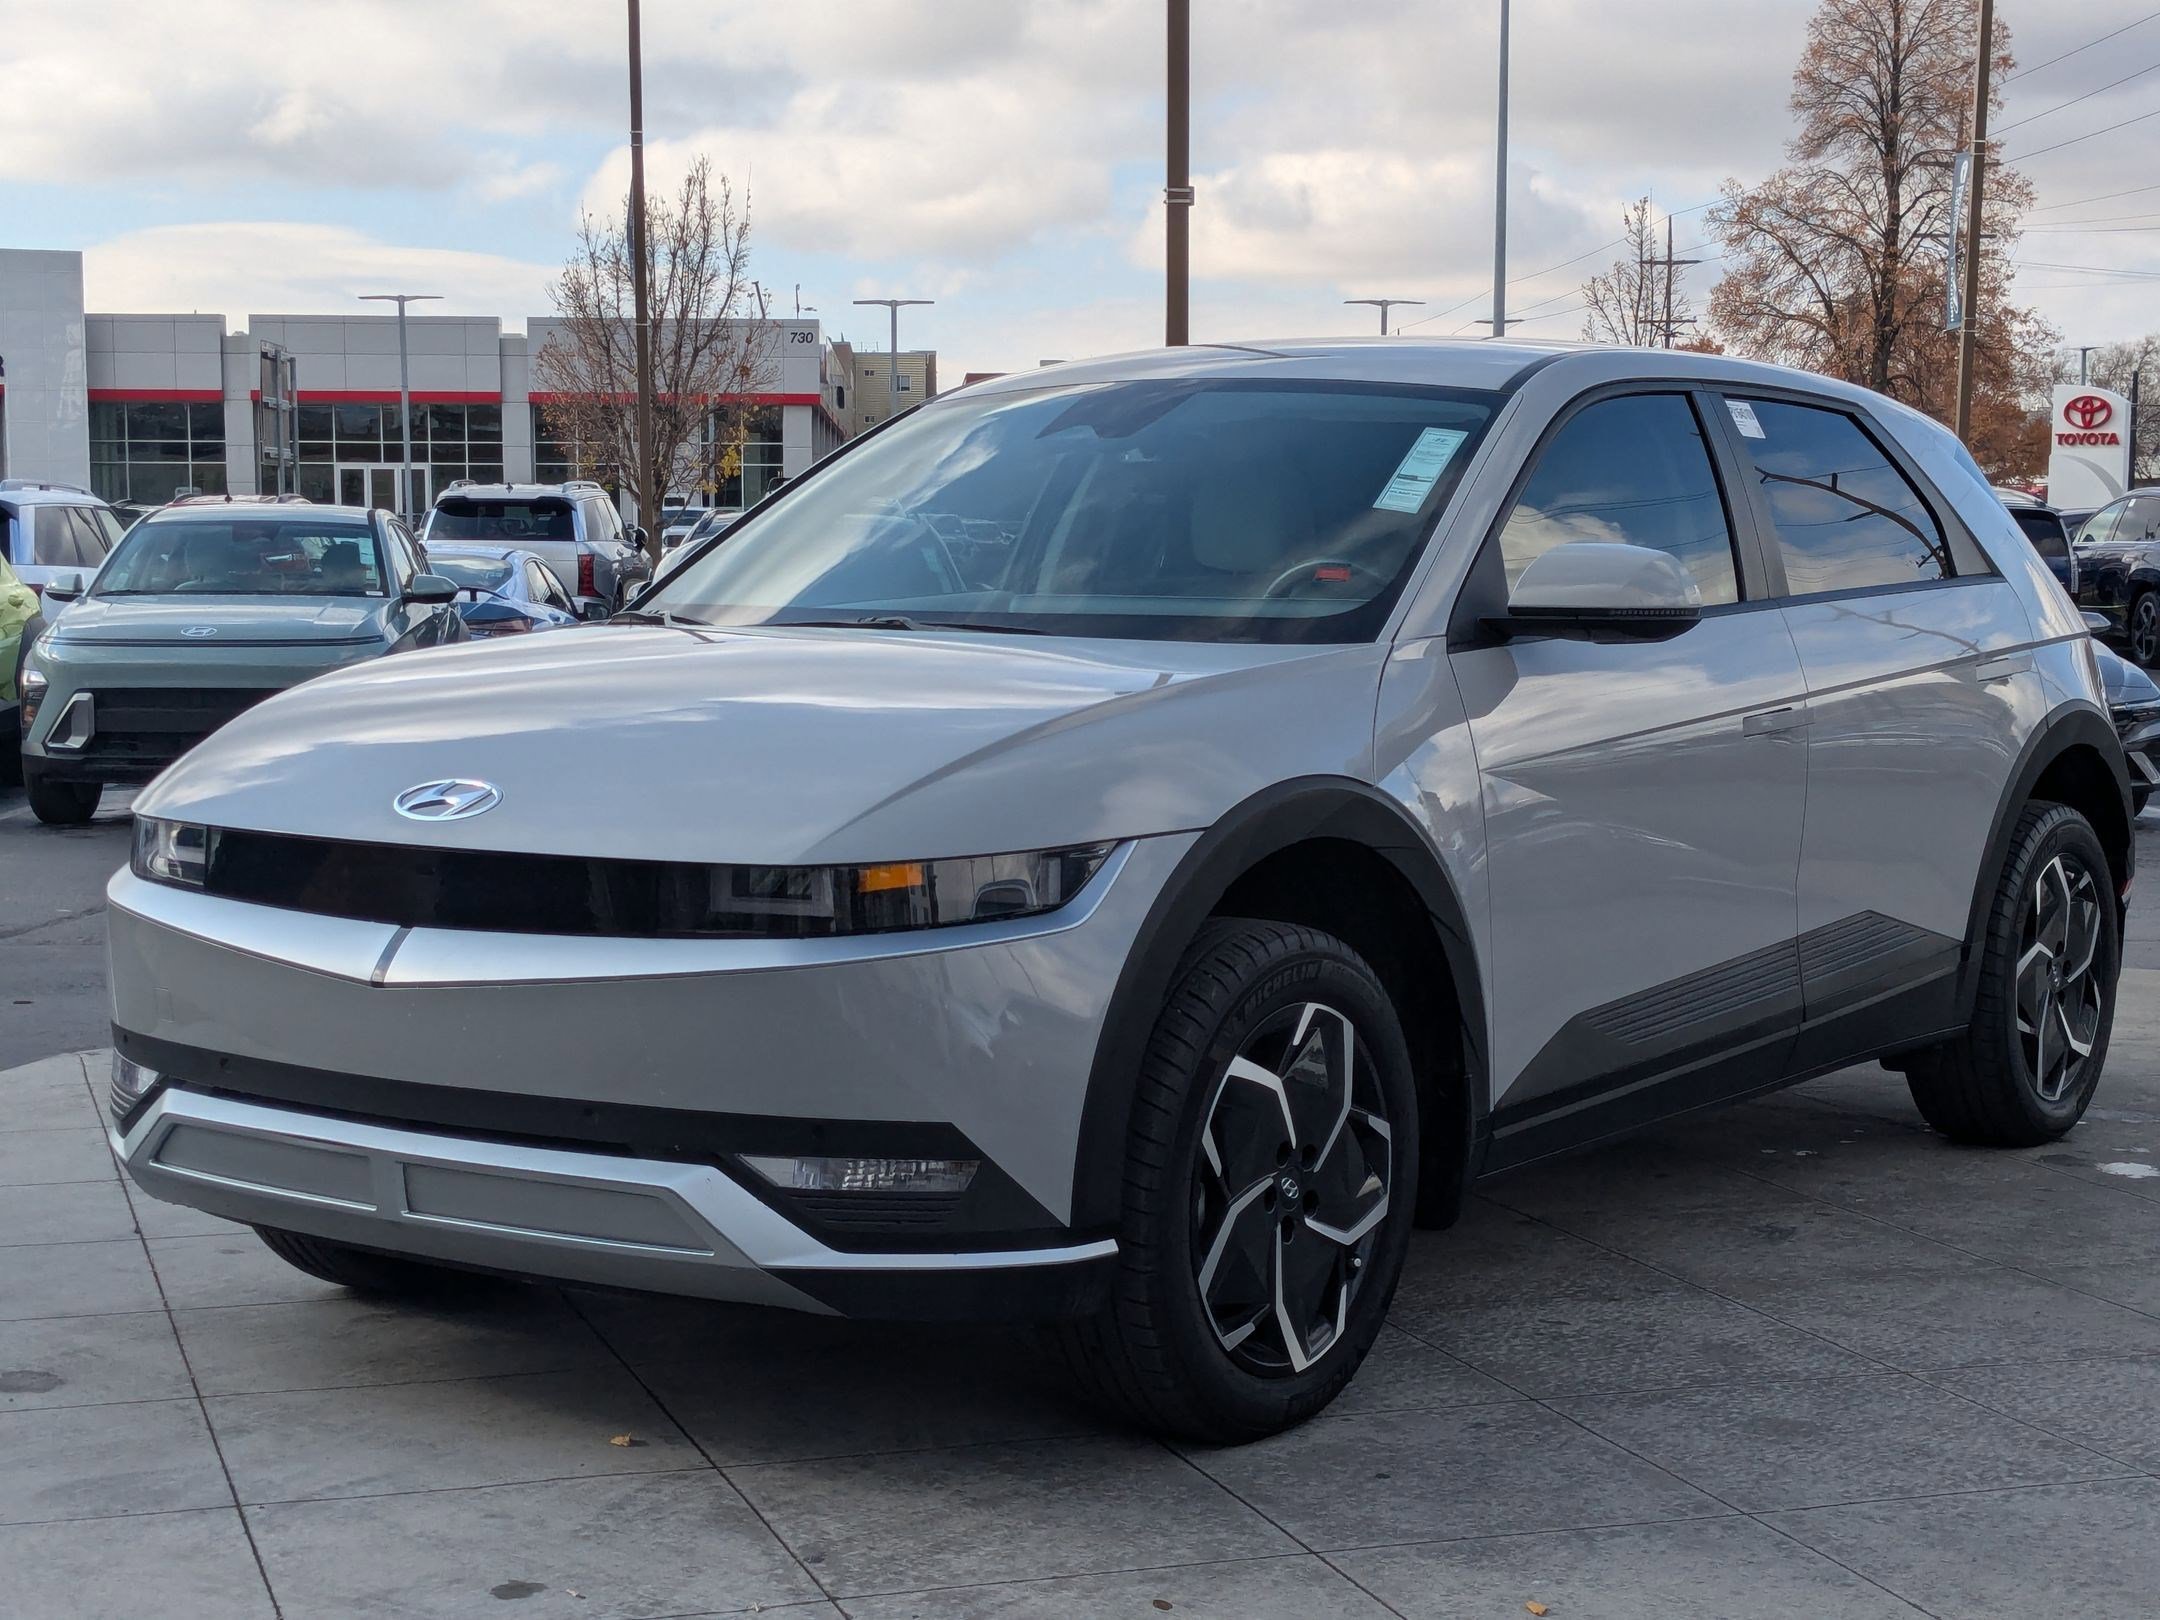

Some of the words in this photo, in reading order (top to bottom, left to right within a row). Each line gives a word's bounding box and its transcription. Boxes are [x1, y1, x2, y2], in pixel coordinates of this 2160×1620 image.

[790, 331, 814, 344] 730
[2055, 432, 2120, 446] TOYOTA
[1245, 962, 1319, 1015] MICHELIN
